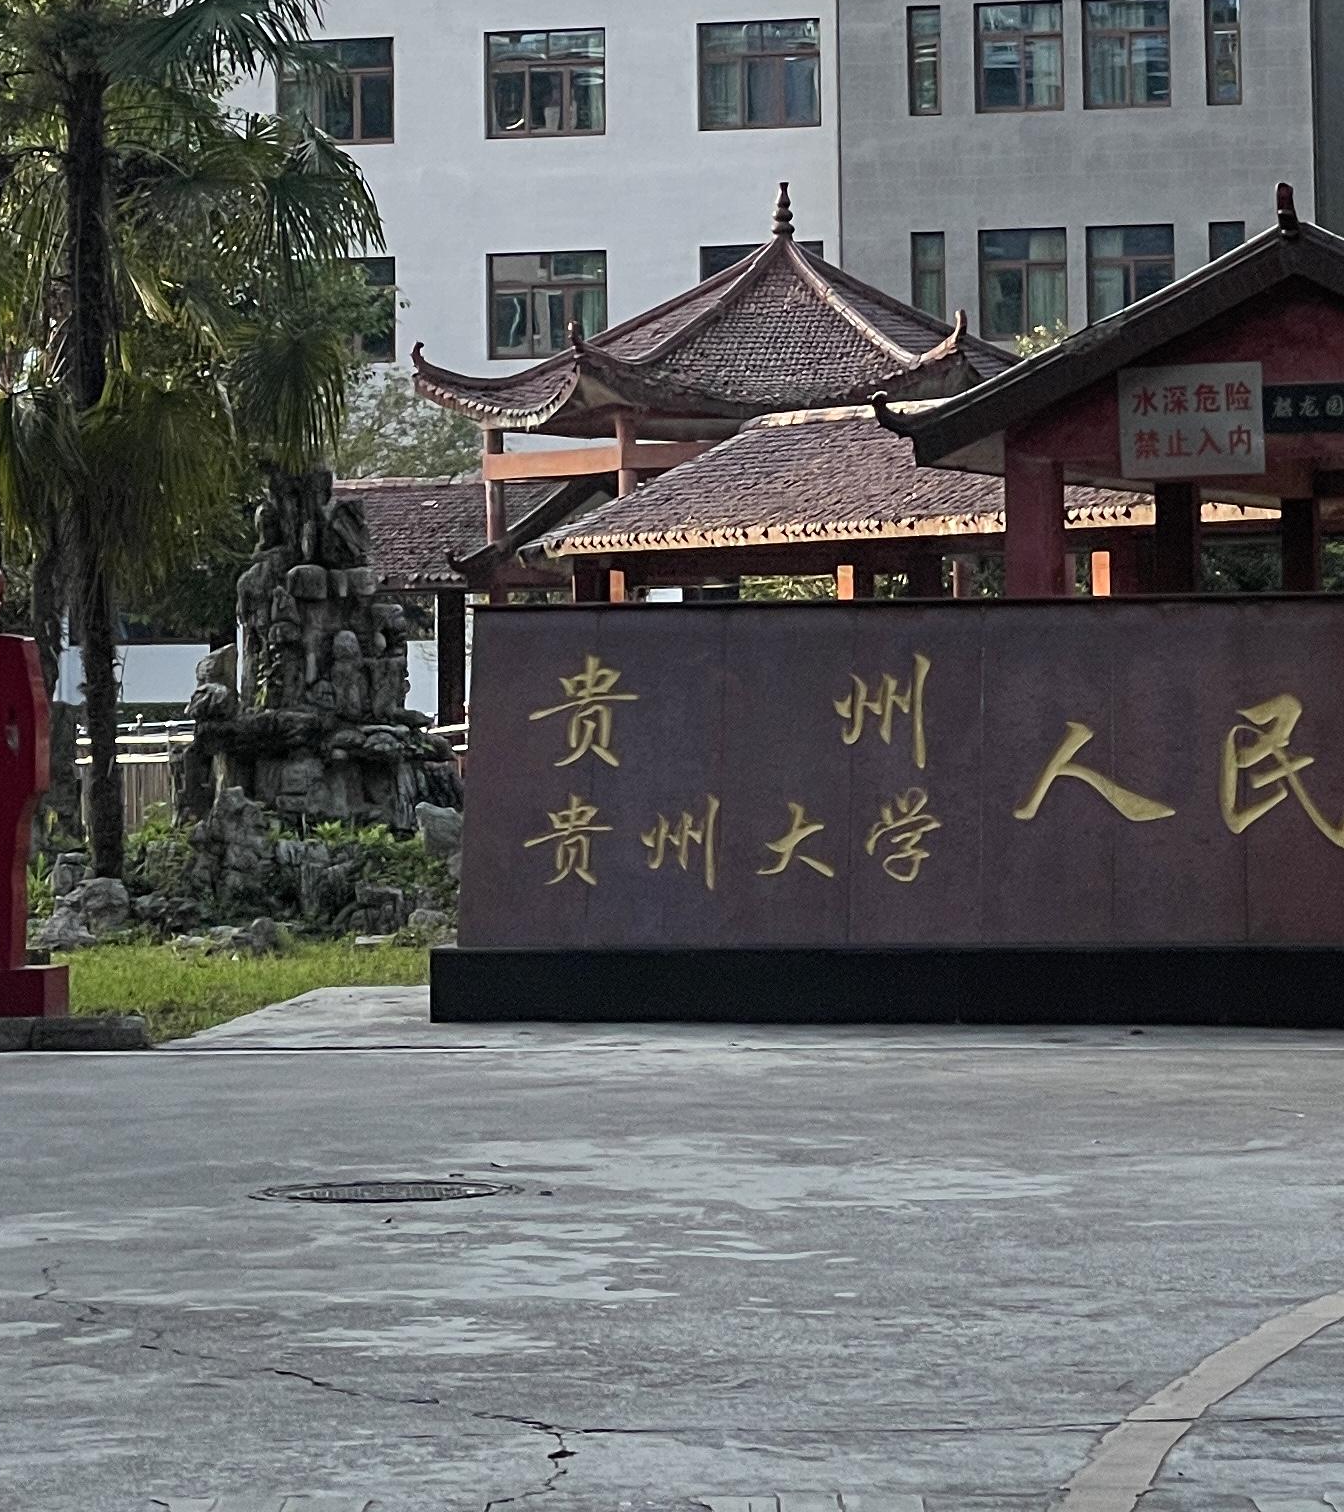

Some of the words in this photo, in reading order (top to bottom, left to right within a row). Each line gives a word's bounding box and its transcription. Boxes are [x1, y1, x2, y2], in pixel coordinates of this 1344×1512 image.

[1131, 380, 1253, 417] 水深危险
[1133, 423, 1253, 460] 禁止入内
[528, 653, 932, 769] 贵州
[522, 787, 943, 891] 贵州大学
